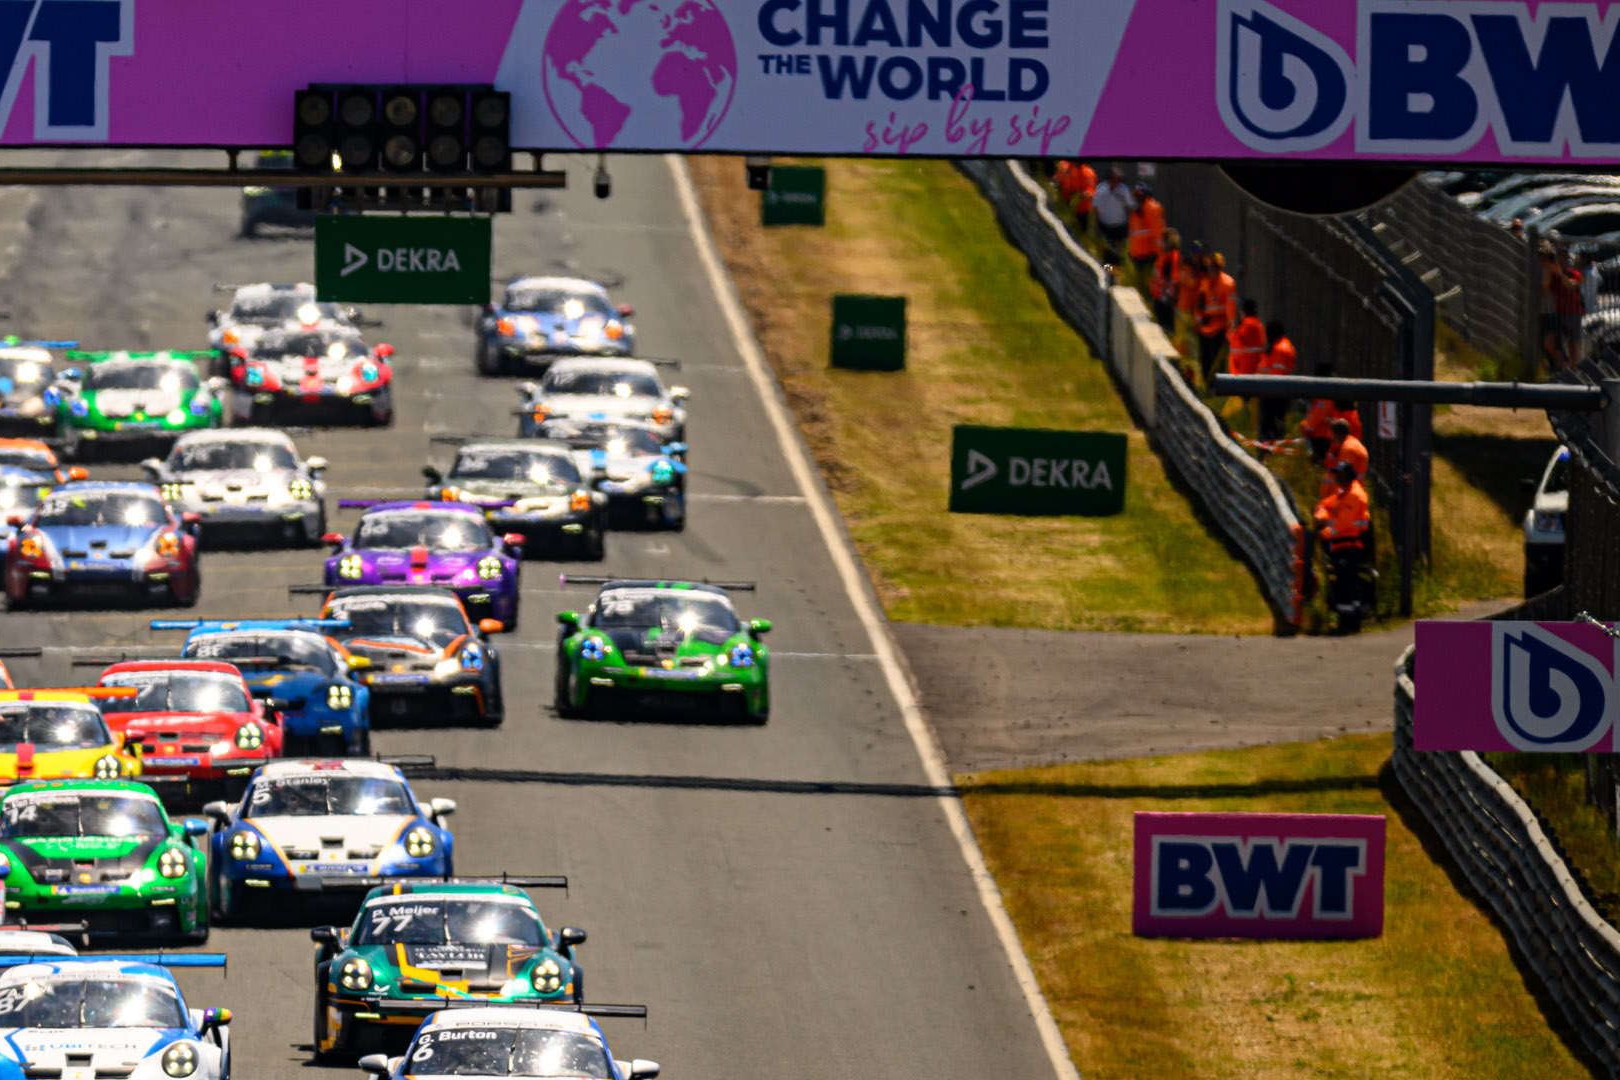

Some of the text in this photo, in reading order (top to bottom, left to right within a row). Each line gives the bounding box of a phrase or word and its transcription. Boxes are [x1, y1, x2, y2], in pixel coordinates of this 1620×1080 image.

[757, 0, 1049, 49] CHANGE
[757, 54, 1050, 102] THE WORLD
[861, 110, 929, 155] sip
[1006, 104, 1072, 156] sip
[376, 247, 461, 273] DEKRA
[1008, 457, 1114, 491] DEKRA
[252, 787, 273, 805] 5
[1156, 841, 1362, 916] BWT
[371, 914, 414, 936] 77
[389, 905, 440, 919] Meijer
[418, 1029, 498, 1046] G. Burton
[411, 1042, 434, 1063] 6
